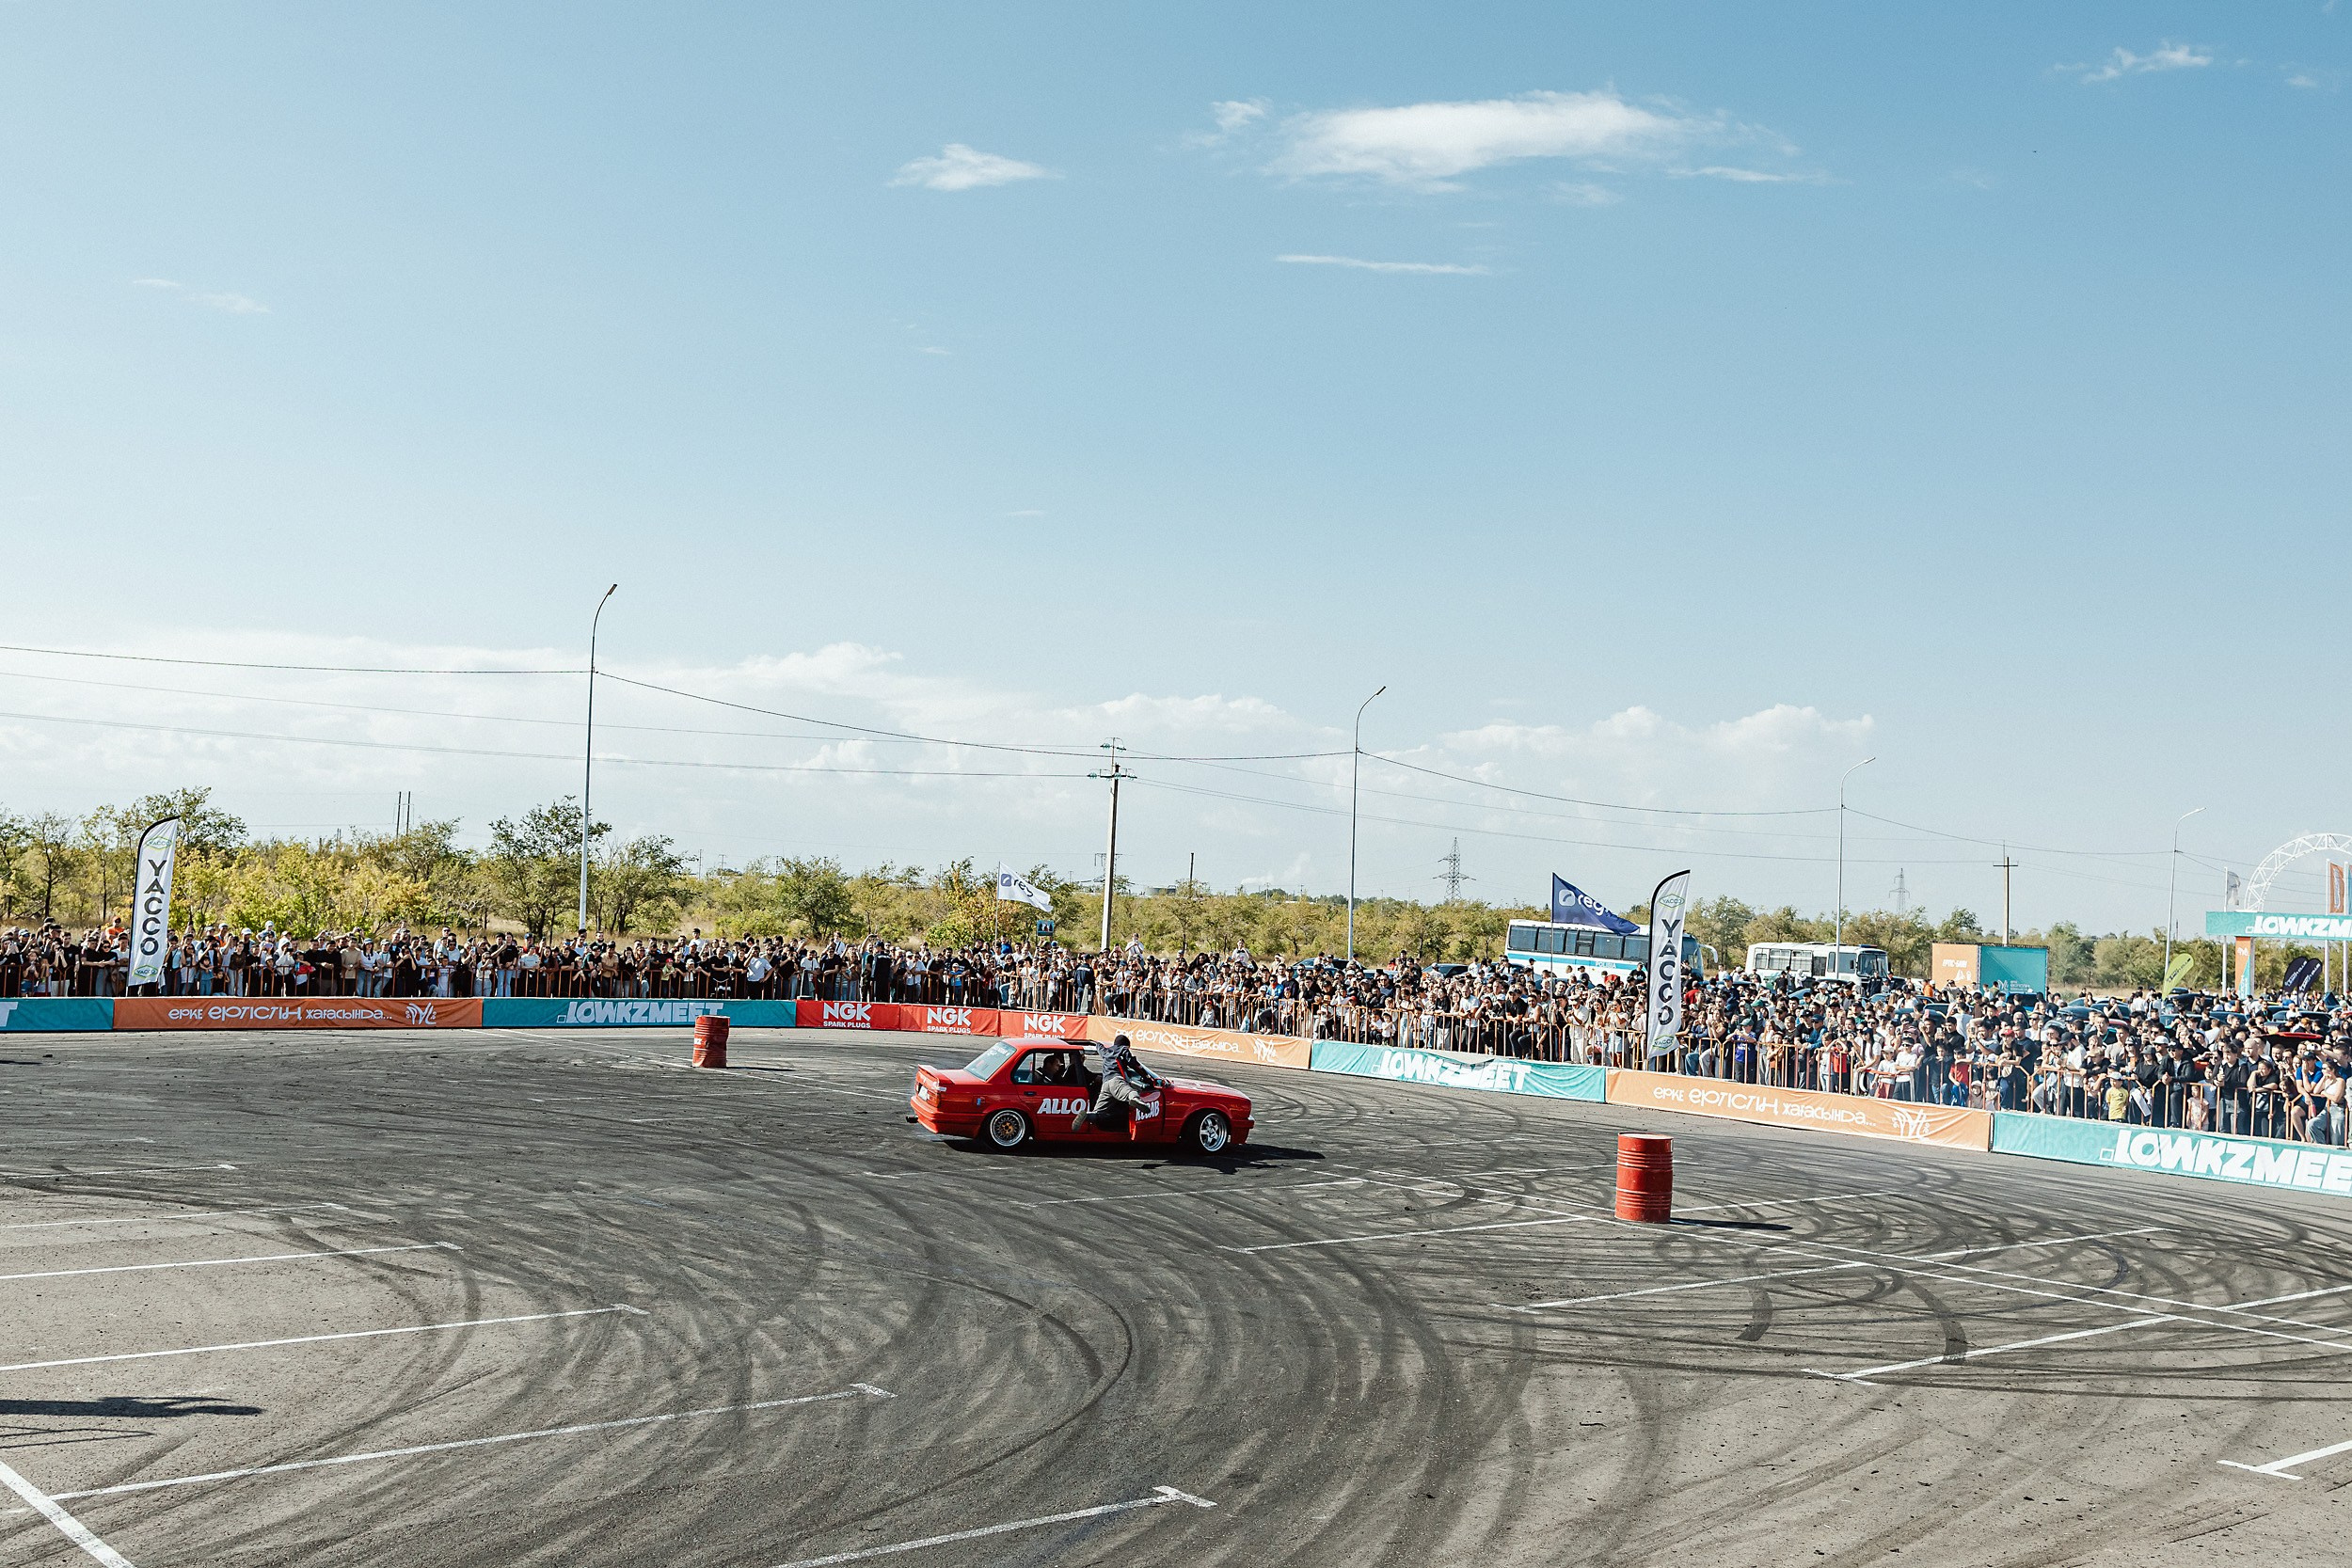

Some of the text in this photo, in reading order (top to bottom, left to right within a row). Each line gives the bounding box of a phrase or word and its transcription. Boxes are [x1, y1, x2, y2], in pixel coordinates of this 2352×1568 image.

[140, 859, 167, 956] YACCO
[2254, 915, 2352, 938] LOWKZM
[1658, 918, 1681, 1026] YACCO
[823, 1002, 871, 1022] NGK
[927, 1007, 972, 1027] NGK
[1024, 1013, 1066, 1034] NGK
[2113, 1129, 2352, 1193] LOWKZMEE
